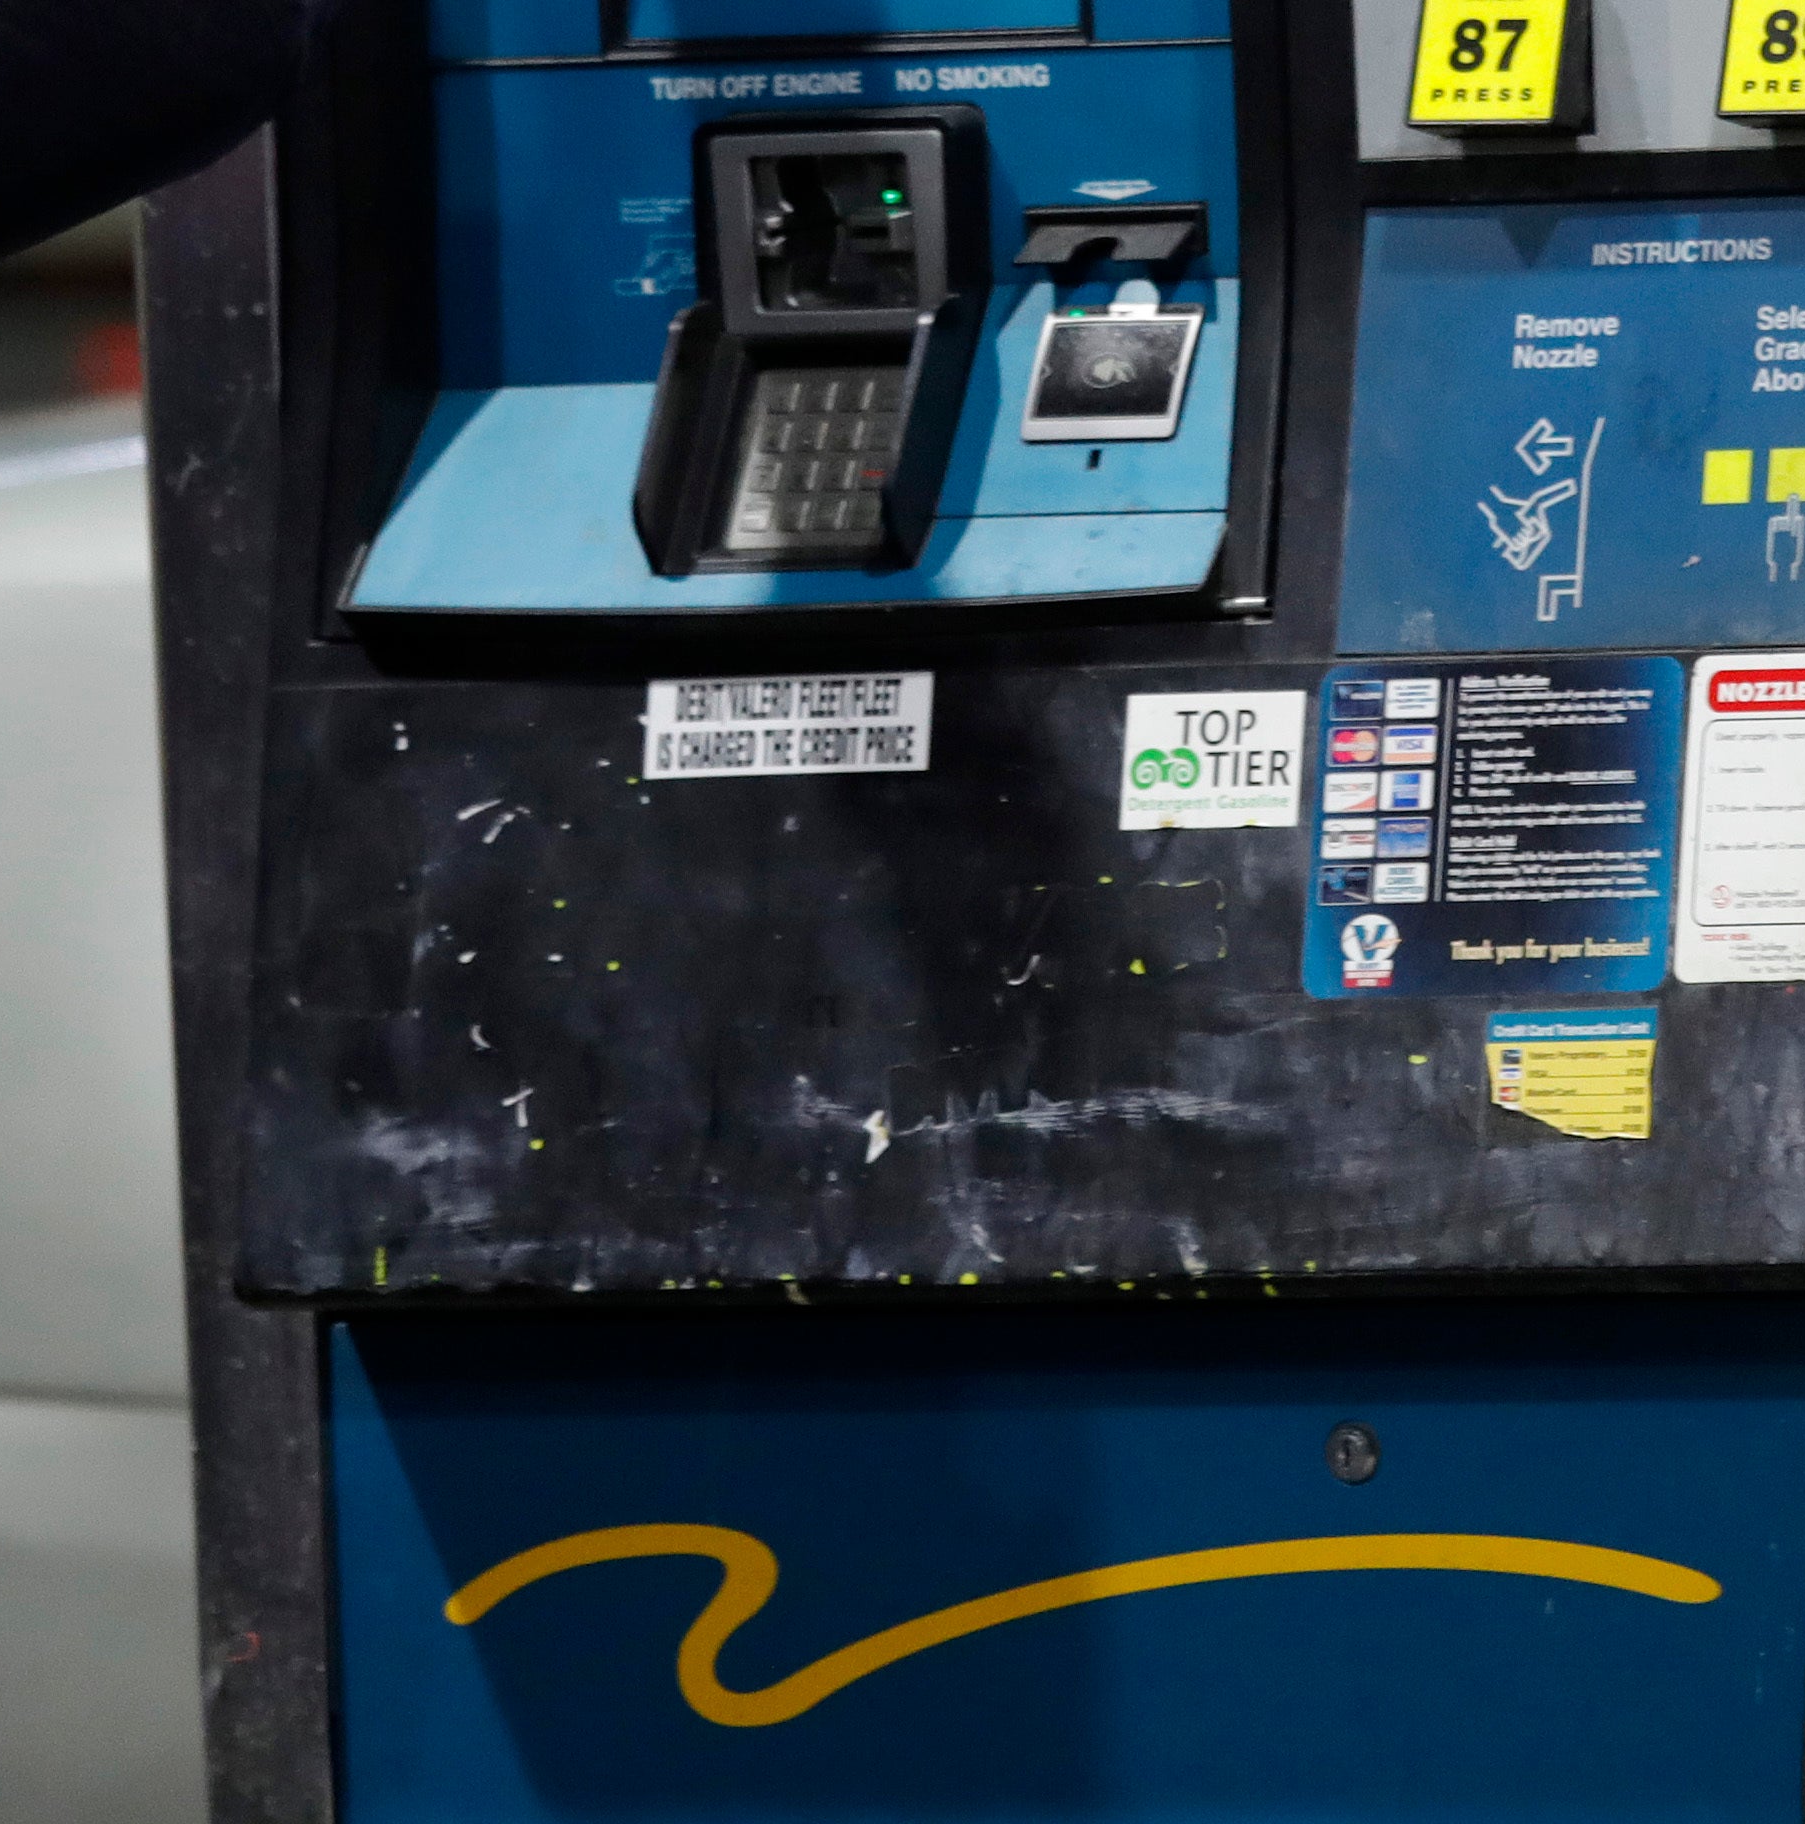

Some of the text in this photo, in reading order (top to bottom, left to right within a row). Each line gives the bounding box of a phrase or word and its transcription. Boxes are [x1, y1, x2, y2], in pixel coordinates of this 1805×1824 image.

[1448, 18, 1530, 74] 87
[648, 71, 863, 102] TURN OFF ENGINE
[894, 63, 1051, 93] NO SMOKING
[1430, 87, 1535, 103] PRESS
[1591, 237, 1773, 267] INSTRUCTIONS
[1514, 312, 1621, 339] Remove
[1512, 342, 1599, 370] Nozzle
[1175, 709, 1257, 747] TOP
[656, 725, 914, 771] IS CHARGED THE CREDIT PRICE
[1204, 749, 1292, 788] TIER
[1127, 793, 1291, 813] Detergent Gasoline
[1450, 936, 1651, 966] Thank you for your business!
